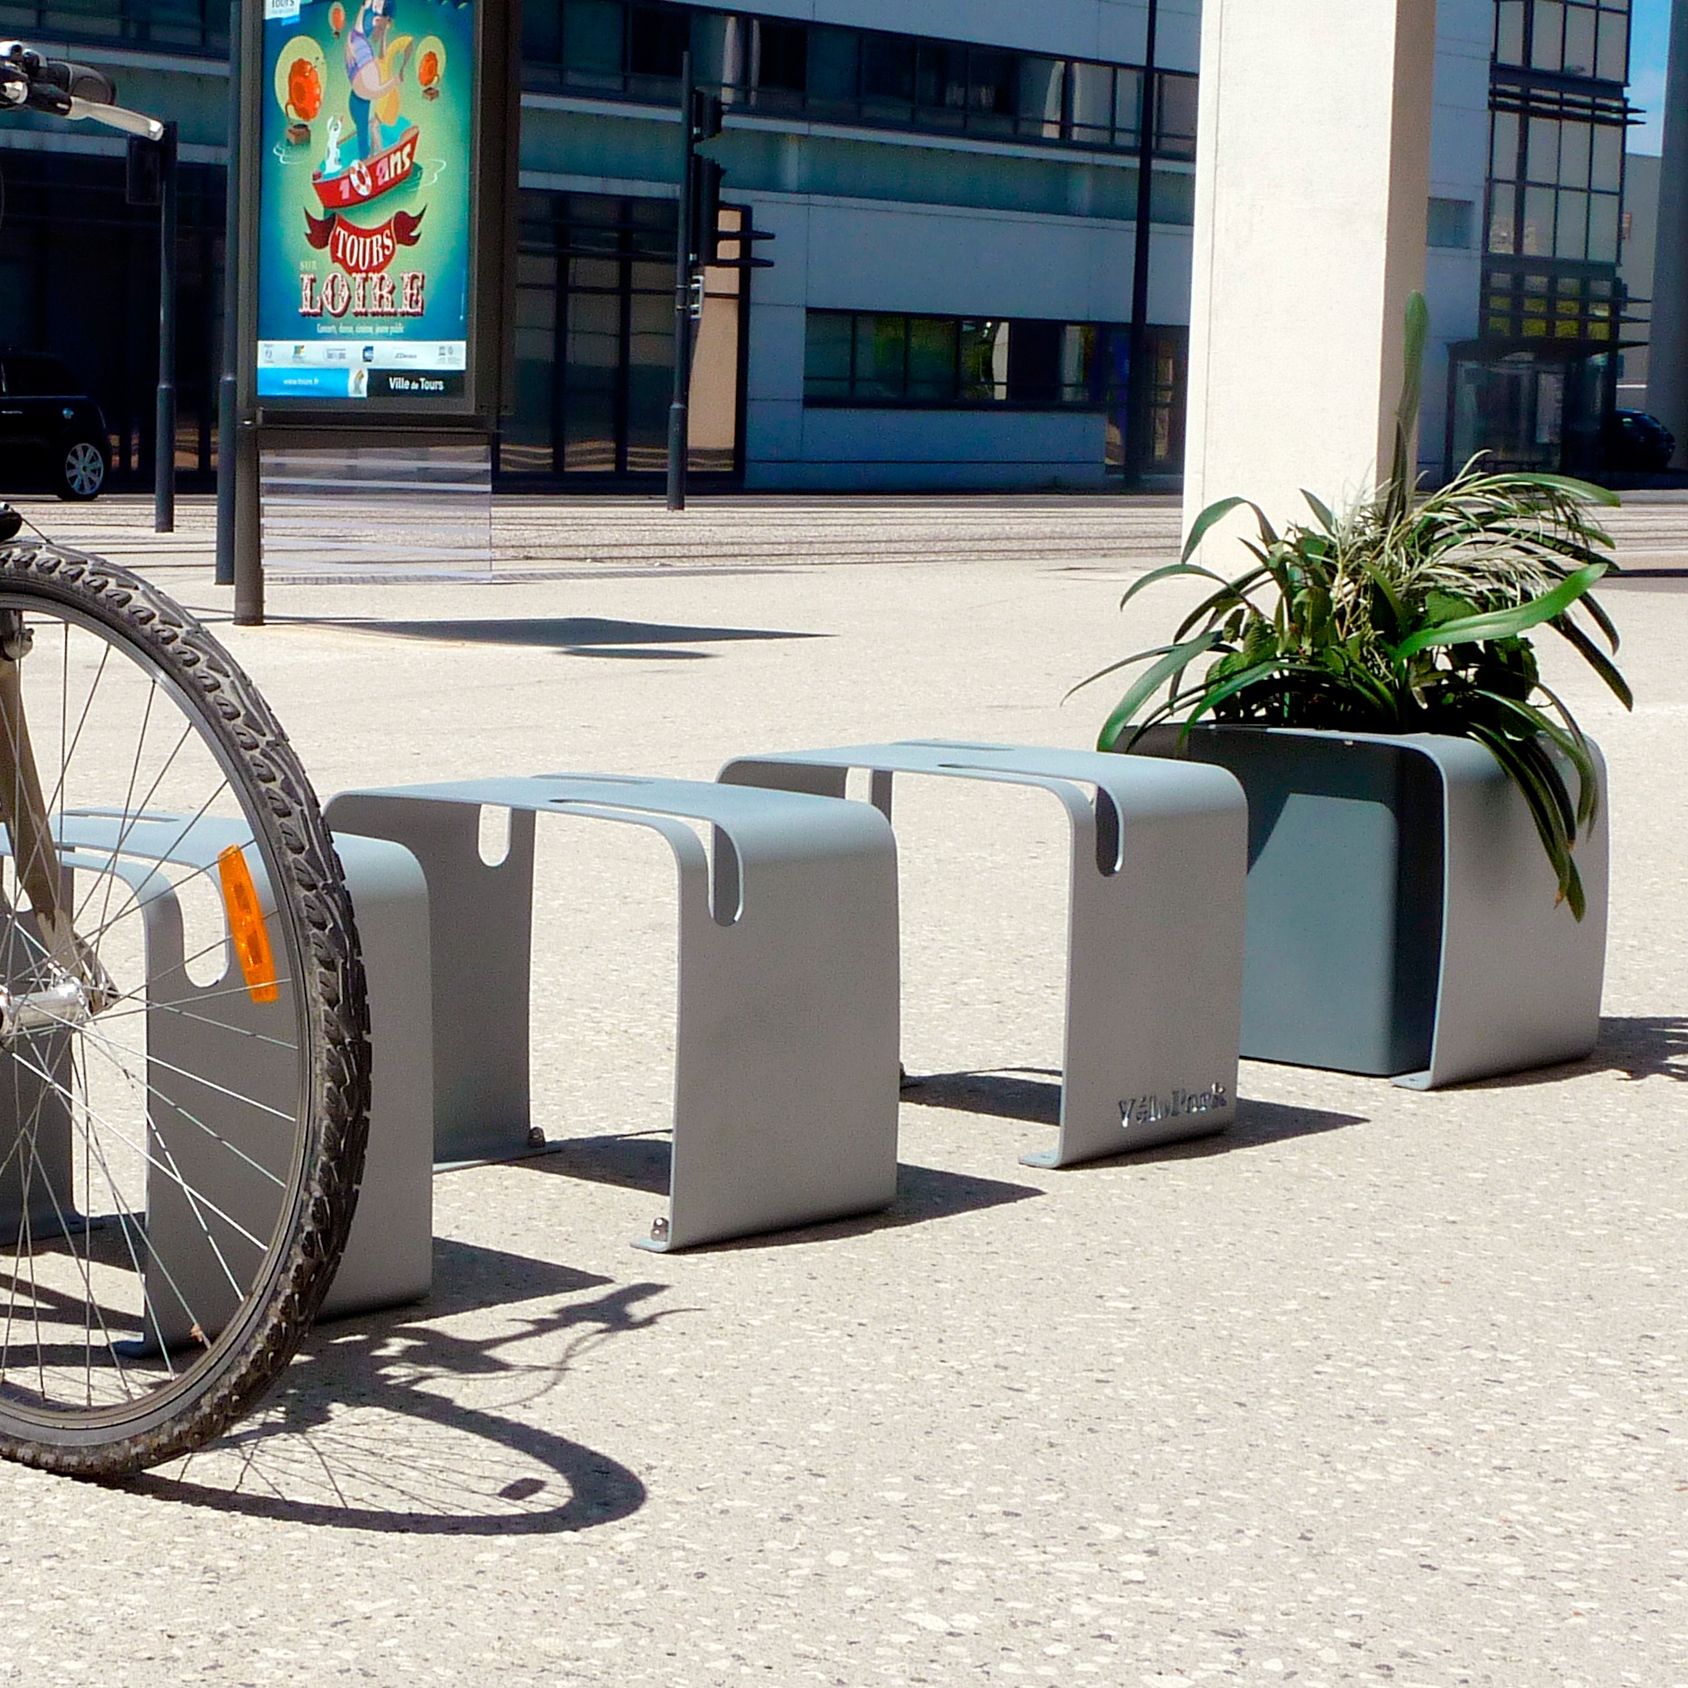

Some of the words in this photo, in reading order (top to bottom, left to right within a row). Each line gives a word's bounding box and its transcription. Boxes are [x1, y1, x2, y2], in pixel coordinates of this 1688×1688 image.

[336, 227, 393, 270] TOURS
[298, 271, 425, 317] LOIRE
[388, 376, 411, 391] Ville
[410, 380, 420, 391] de
[419, 377, 445, 391] Tours
